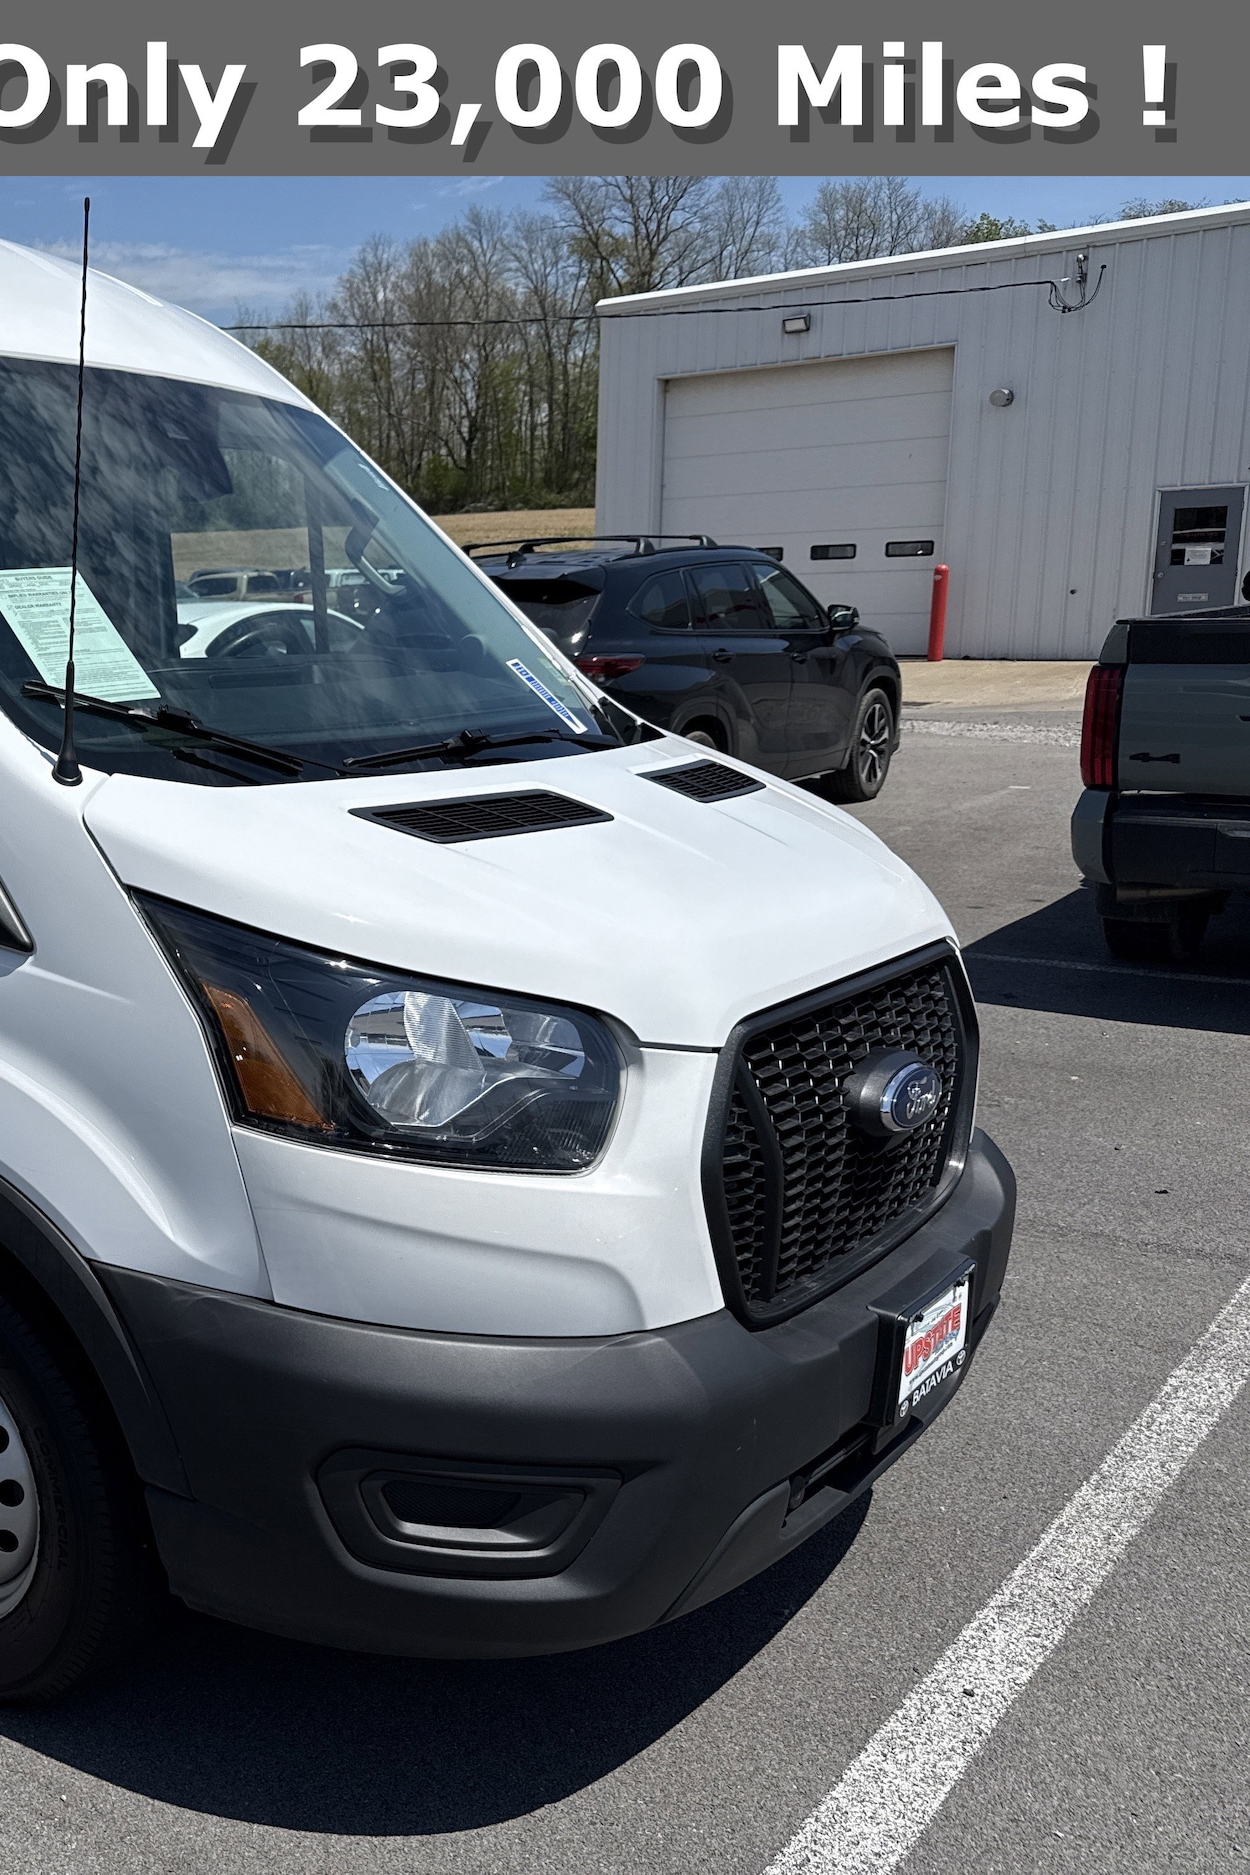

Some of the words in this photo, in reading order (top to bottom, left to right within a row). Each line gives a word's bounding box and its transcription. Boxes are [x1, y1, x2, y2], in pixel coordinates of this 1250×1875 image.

[906, 1076, 937, 1120] Ford
[904, 1302, 962, 1377] UPSTATE
[911, 1360, 954, 1407] BATAVIA
